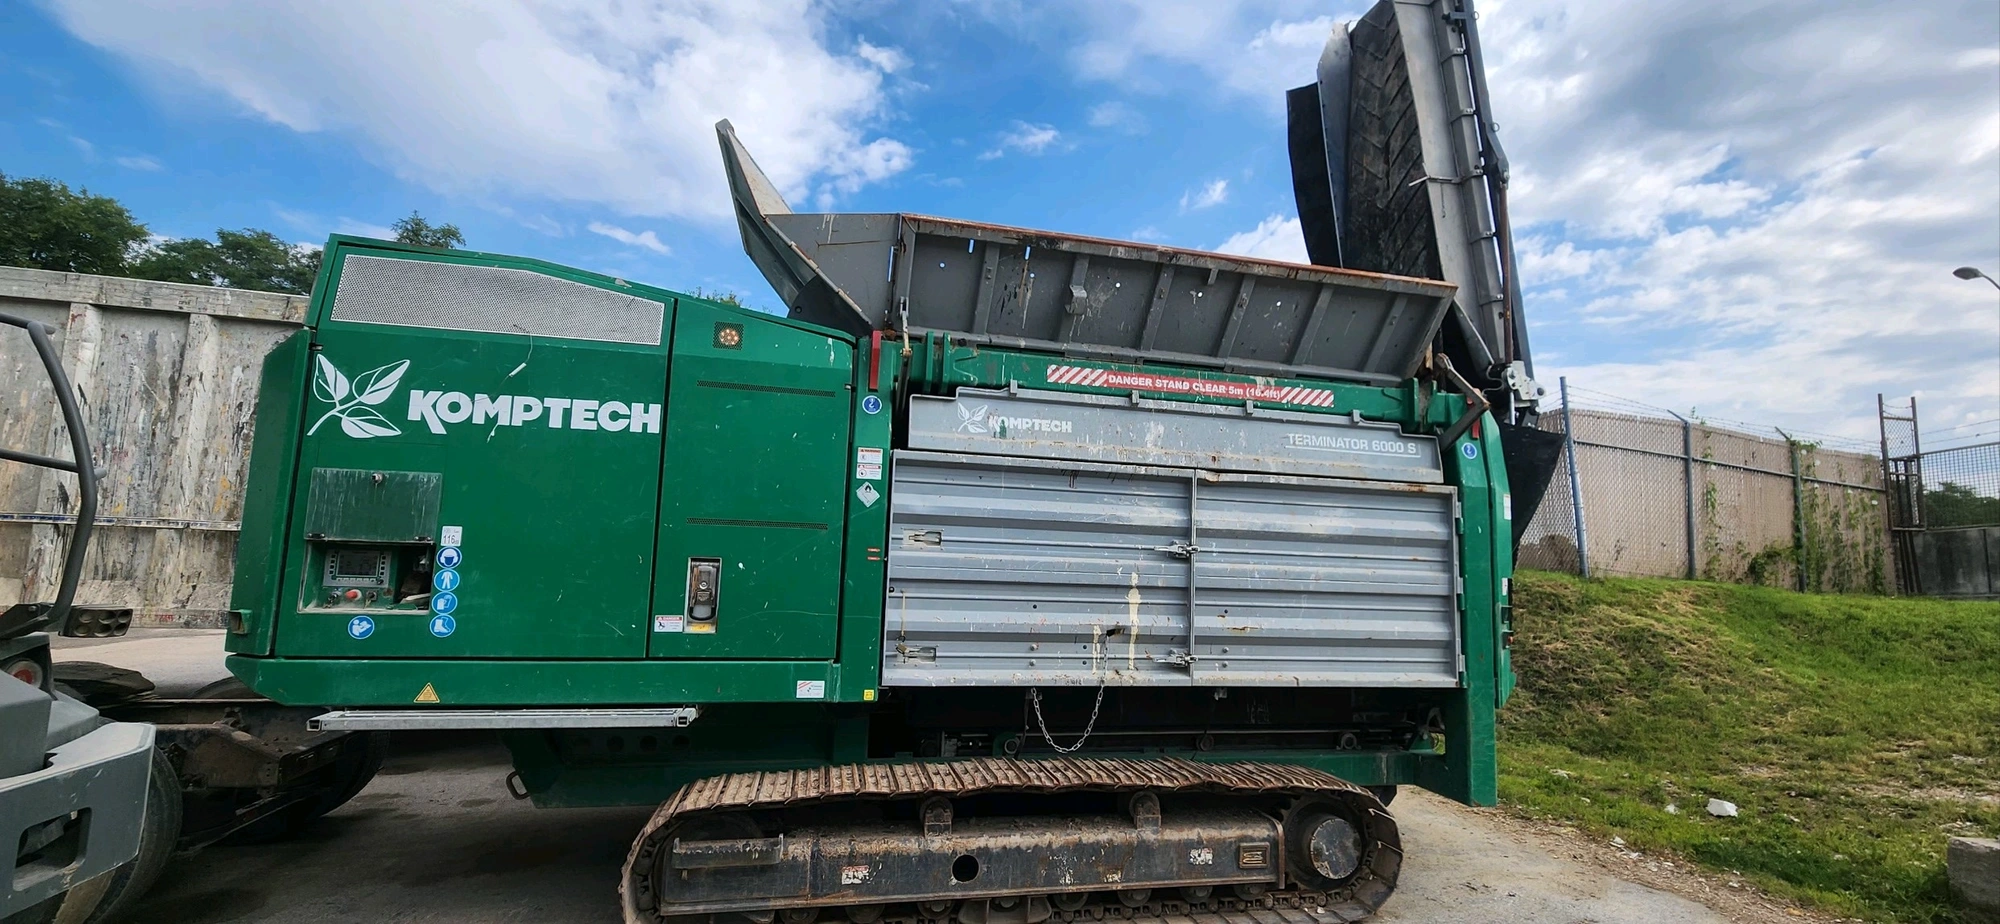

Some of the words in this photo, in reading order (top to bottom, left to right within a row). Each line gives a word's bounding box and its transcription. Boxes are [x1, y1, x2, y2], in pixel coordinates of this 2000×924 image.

[1108, 374, 1153, 387] DANGER
[1155, 379, 1190, 390] STAND
[1192, 382, 1227, 394] CLEAR
[1228, 385, 1244, 395] 5m
[407, 389, 662, 435] KOMPTECH
[988, 414, 1073, 433] KOMPTECH
[1286, 433, 1369, 450] TERMINATOR
[1372, 441, 1405, 453] 6000
[1407, 443, 1417, 454] S
[443, 534, 456, 545] 116
